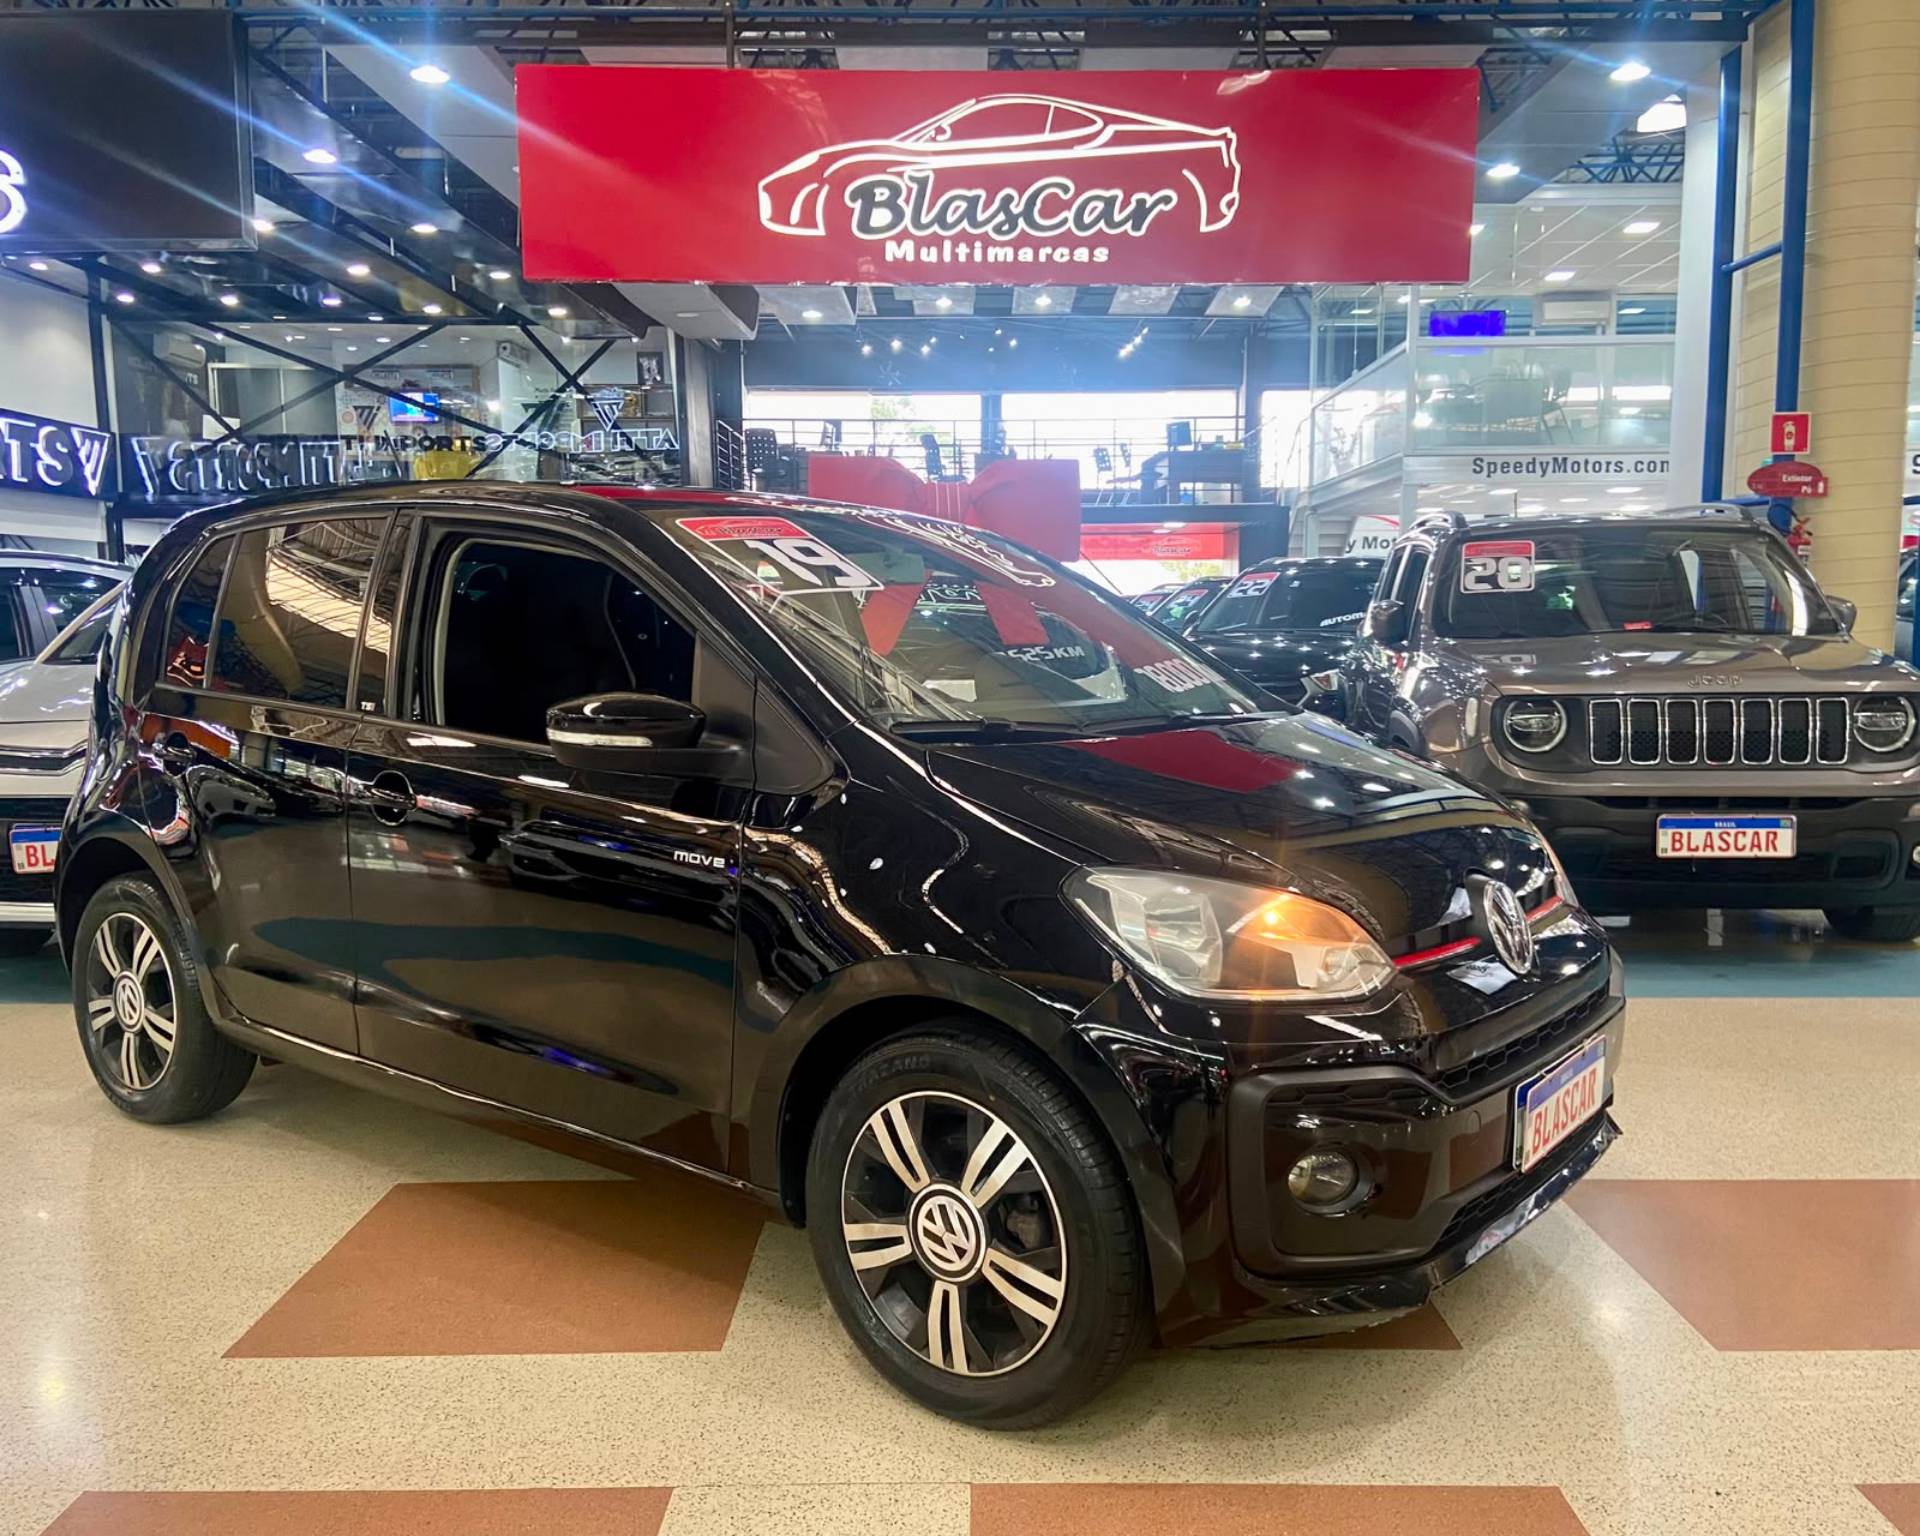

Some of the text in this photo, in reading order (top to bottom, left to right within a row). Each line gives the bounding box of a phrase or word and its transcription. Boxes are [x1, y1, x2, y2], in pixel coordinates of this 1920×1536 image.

[846, 171, 1177, 240] BlasCar
[884, 239, 1110, 263] Multimarcas
[743, 538, 872, 587] 19
[1319, 612, 1365, 627] AUTOM
[1671, 831, 1778, 852] BLASCAR
[673, 850, 726, 869] move
[1532, 1067, 1598, 1154] BLASCAR
